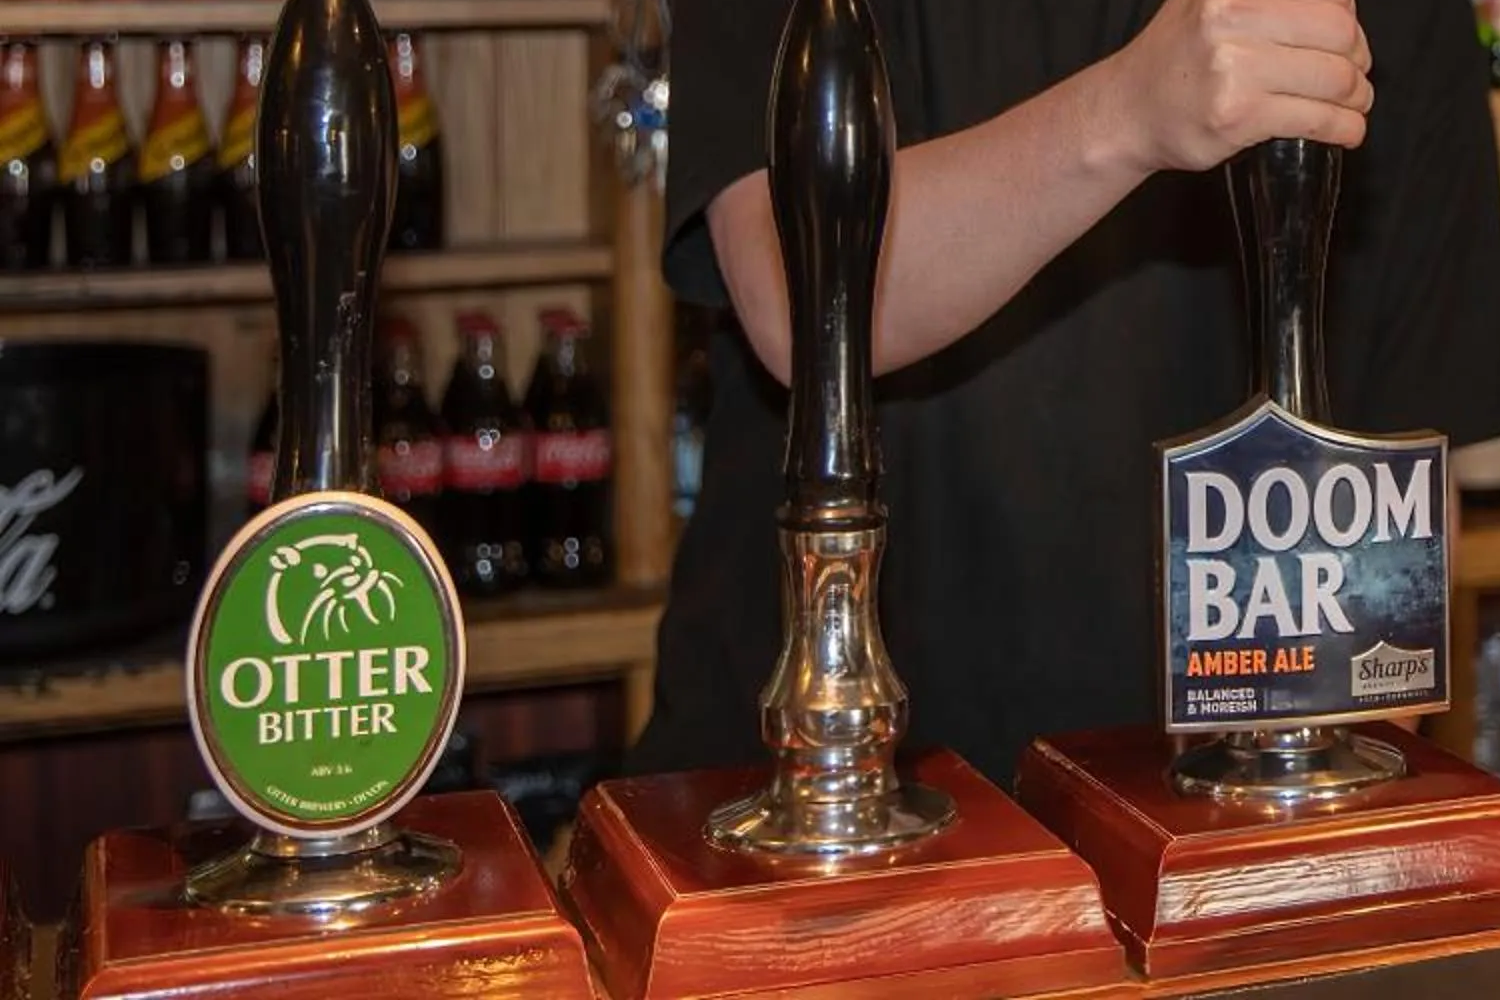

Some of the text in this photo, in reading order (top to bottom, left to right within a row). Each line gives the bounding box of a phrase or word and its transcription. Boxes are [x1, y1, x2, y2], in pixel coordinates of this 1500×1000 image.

[1185, 459, 1432, 553] DOOM
[1186, 552, 1354, 641] BAR
[221, 645, 433, 709] OTTER
[1187, 646, 1315, 677] AMBER ALE
[1359, 656, 1429, 682] Sharp's
[1187, 687, 1255, 702] BALANCED
[1201, 699, 1258, 715] MOREISH
[258, 702, 397, 745] BITTER
